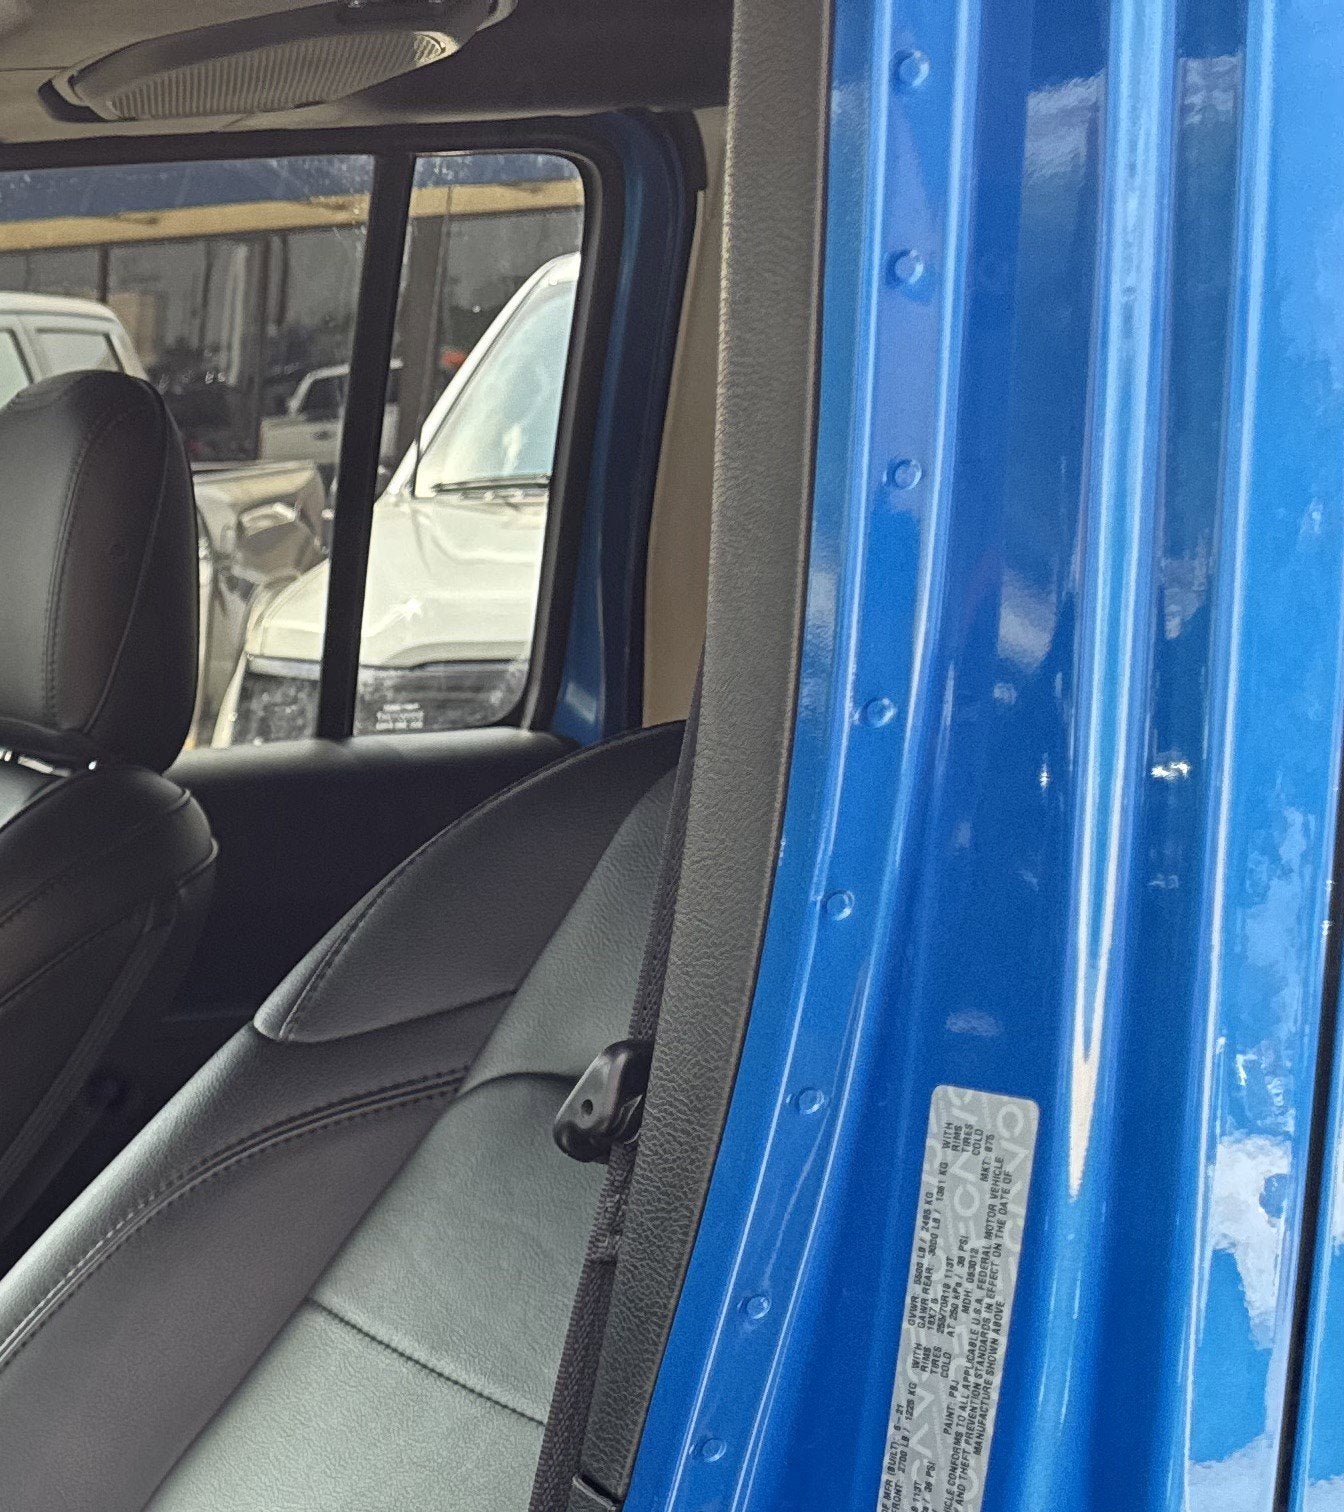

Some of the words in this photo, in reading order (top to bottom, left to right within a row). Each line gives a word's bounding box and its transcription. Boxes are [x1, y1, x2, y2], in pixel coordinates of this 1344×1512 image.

[951, 1124, 962, 1152] RIMS
[961, 1122, 973, 1153] TIRES
[971, 1127, 984, 1156] COLD
[989, 1156, 1004, 1200] VEHICLE
[1002, 1169, 1013, 1185] OF
[998, 1187, 1010, 1215] DATE
[917, 1296, 929, 1329] GAWR
[941, 1121, 953, 1149] WITH
[983, 1202, 997, 1241] MOTOR
[994, 1218, 1006, 1239] THE
[991, 1241, 1002, 1258] ON
[976, 1242, 991, 1291] FEDERAL
[985, 1259, 1000, 1299] EFFECT
[983, 1302, 993, 1313] IN
[911, 1342, 922, 1370] WITH
[920, 1346, 931, 1372] RIMS
[930, 1345, 941, 1376] TIRES
[961, 1327, 978, 1390] APPLICABLE
[973, 1316, 991, 1380] STANDARDS
[939, 1350, 952, 1379] COLD
[958, 1391, 969, 1412] ALL
[972, 1377, 992, 1456] MANUFACTURE
[984, 1336, 999, 1376] SHOWN
[955, 1413, 965, 1429] TO
[963, 1381, 981, 1446] PREVENTION
[947, 1430, 963, 1487] CONFORMS
[958, 1448, 971, 1481] THEFT
[883, 1478, 893, 1500] MFR
[954, 1482, 966, 1506] AND
